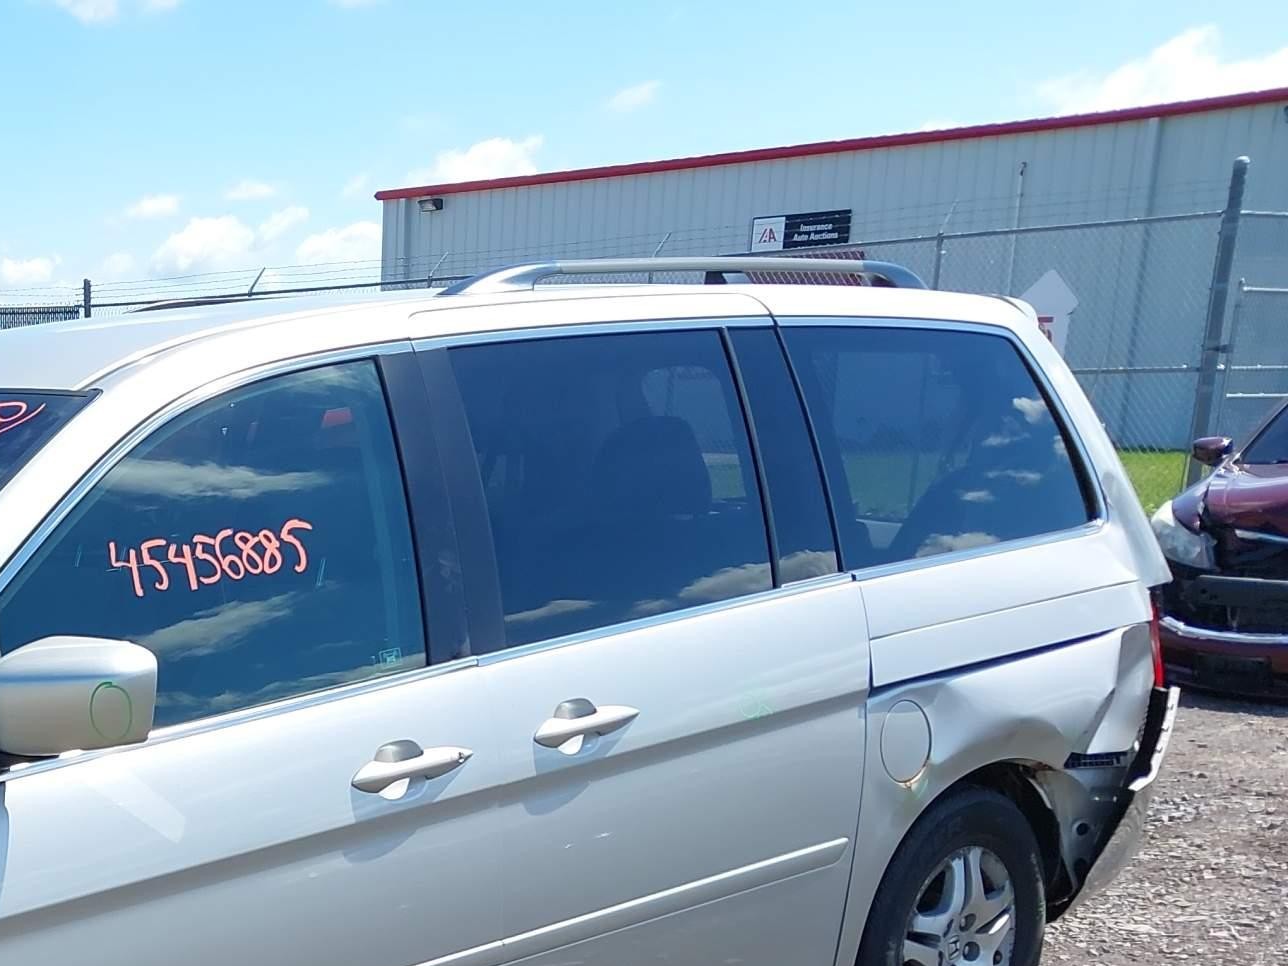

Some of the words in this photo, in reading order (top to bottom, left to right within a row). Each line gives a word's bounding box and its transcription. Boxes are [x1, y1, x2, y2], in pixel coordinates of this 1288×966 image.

[799, 223, 832, 232] Insurance
[793, 233, 809, 241] Auto
[809, 231, 839, 240] Auctions
[109, 518, 312, 597] 45456885
